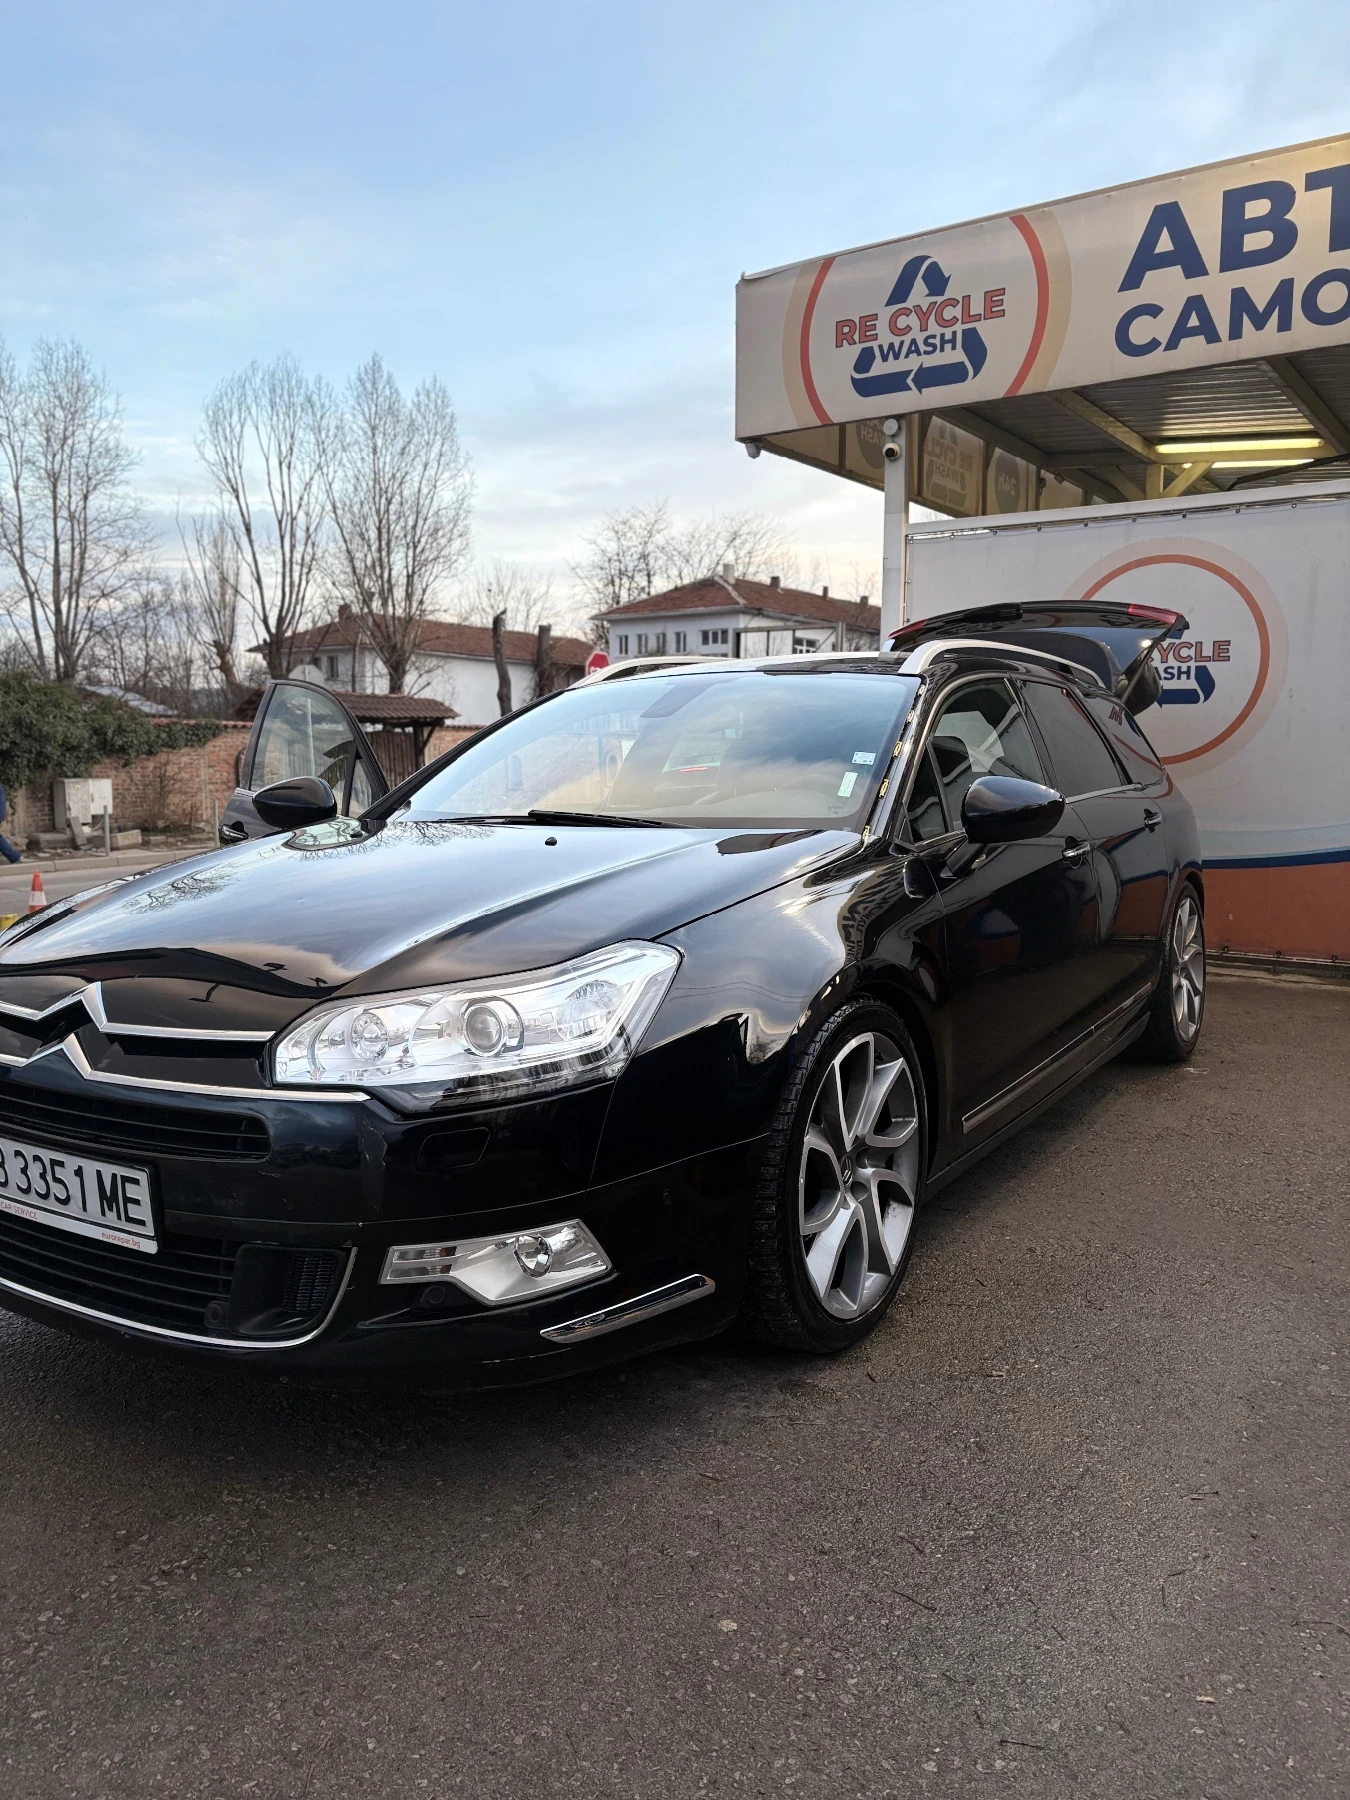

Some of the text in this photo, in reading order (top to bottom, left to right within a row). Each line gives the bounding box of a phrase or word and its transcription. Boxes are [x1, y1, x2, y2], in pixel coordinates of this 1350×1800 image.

[1117, 163, 1350, 292] АВТ
[835, 287, 1006, 348] RE CYCLE
[1114, 268, 1350, 358] САМО
[878, 330, 957, 362] WASH
[1148, 640, 1231, 664] YCLE
[13, 1206, 38, 1219] SERVICE
[14, 1149, 87, 1213] 3351
[96, 1169, 147, 1227] ME
